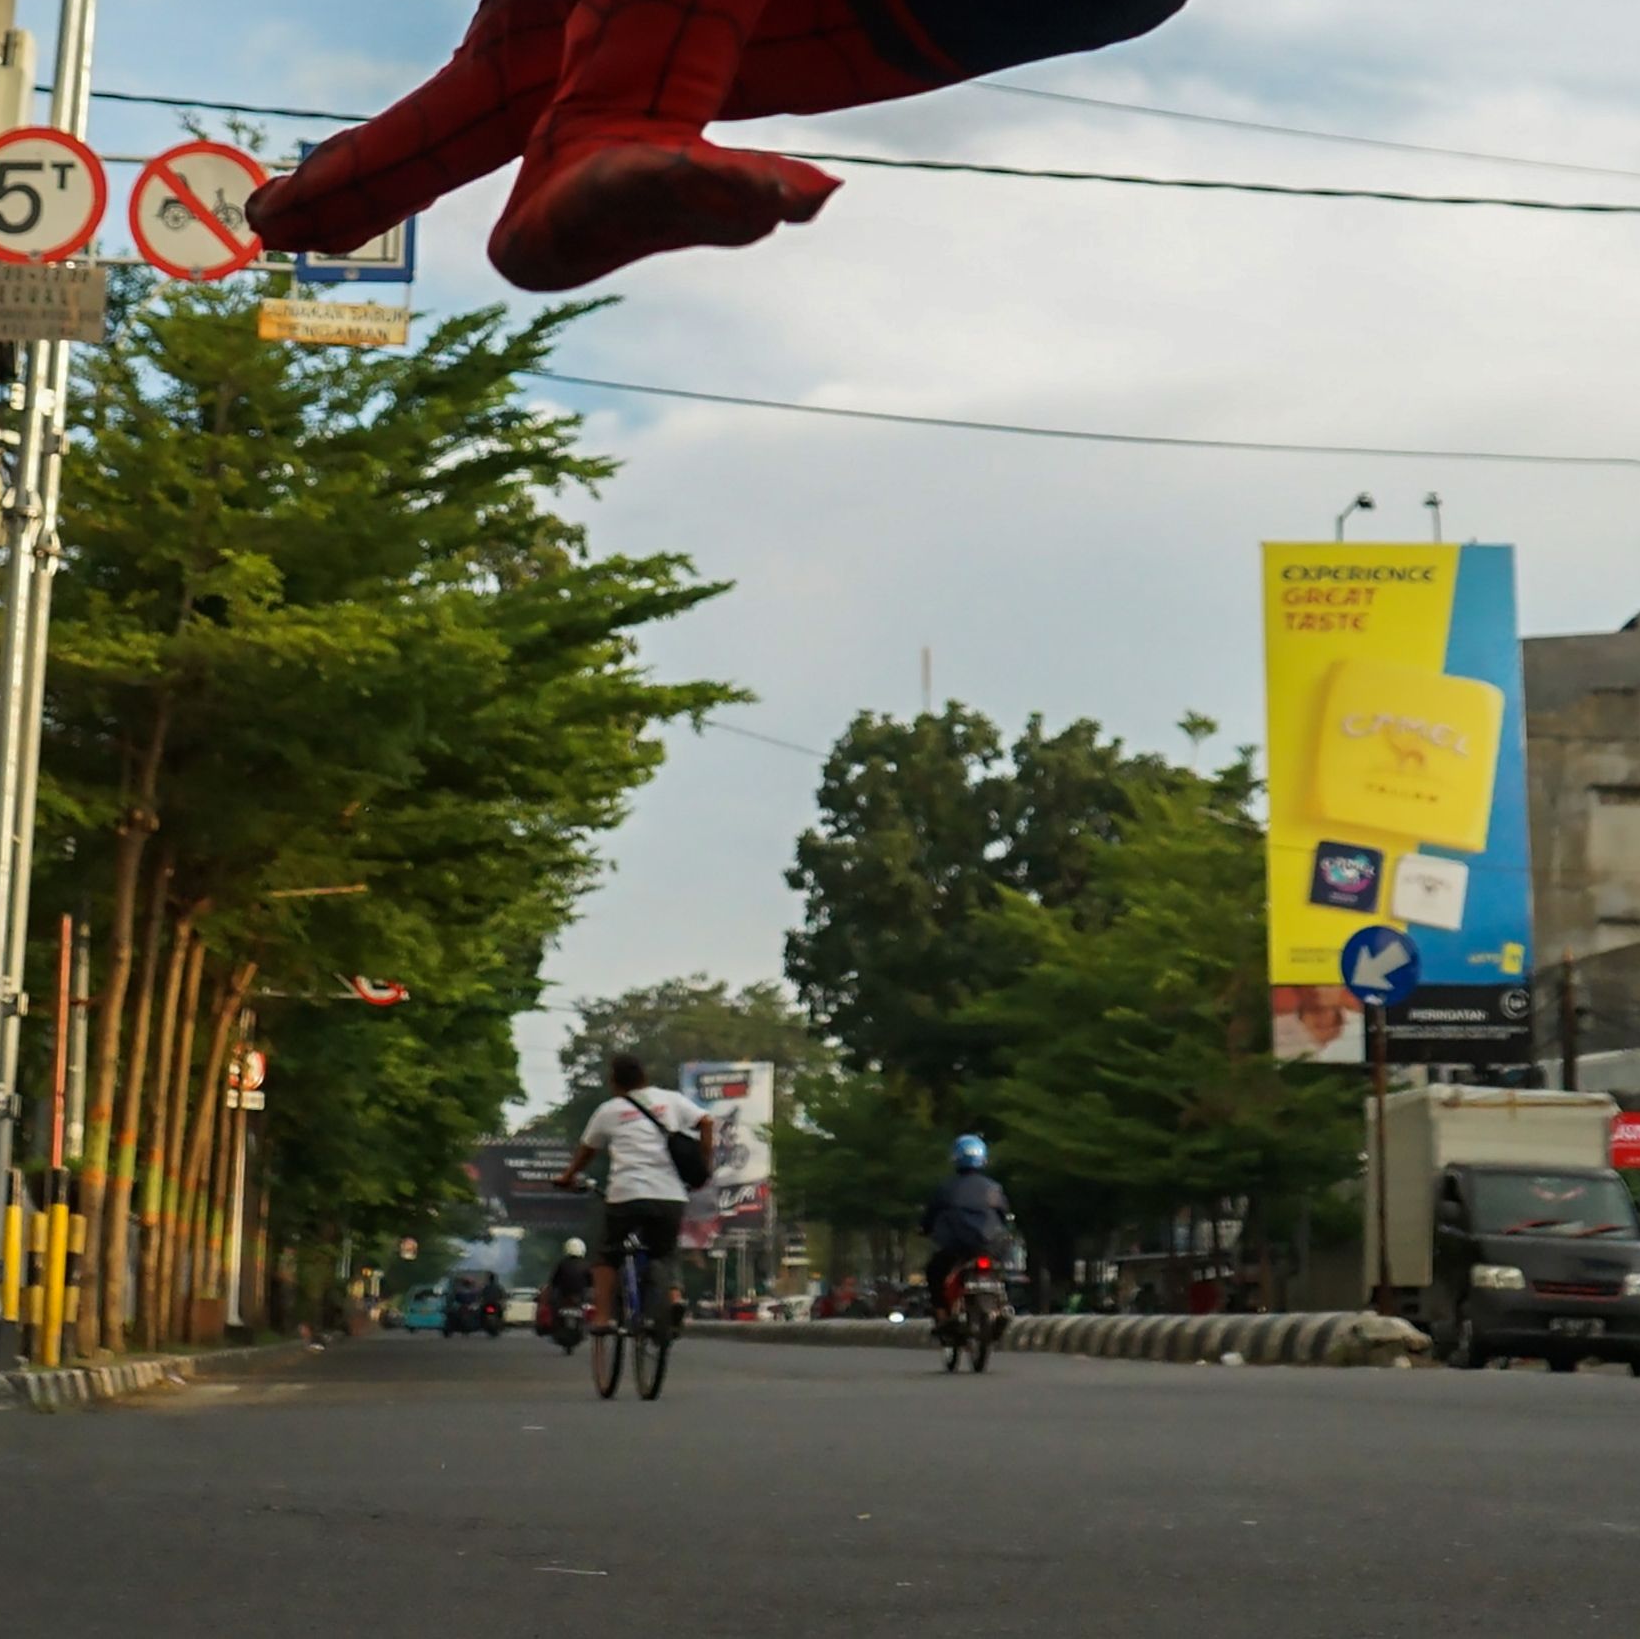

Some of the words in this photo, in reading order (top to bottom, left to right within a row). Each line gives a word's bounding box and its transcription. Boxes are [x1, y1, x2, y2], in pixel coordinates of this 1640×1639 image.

[1281, 563, 1438, 583] EXPERIENCE
[1281, 587, 1379, 607] GREAT
[1283, 612, 1370, 632] TASTE
[1340, 714, 1471, 759] CAMEL
